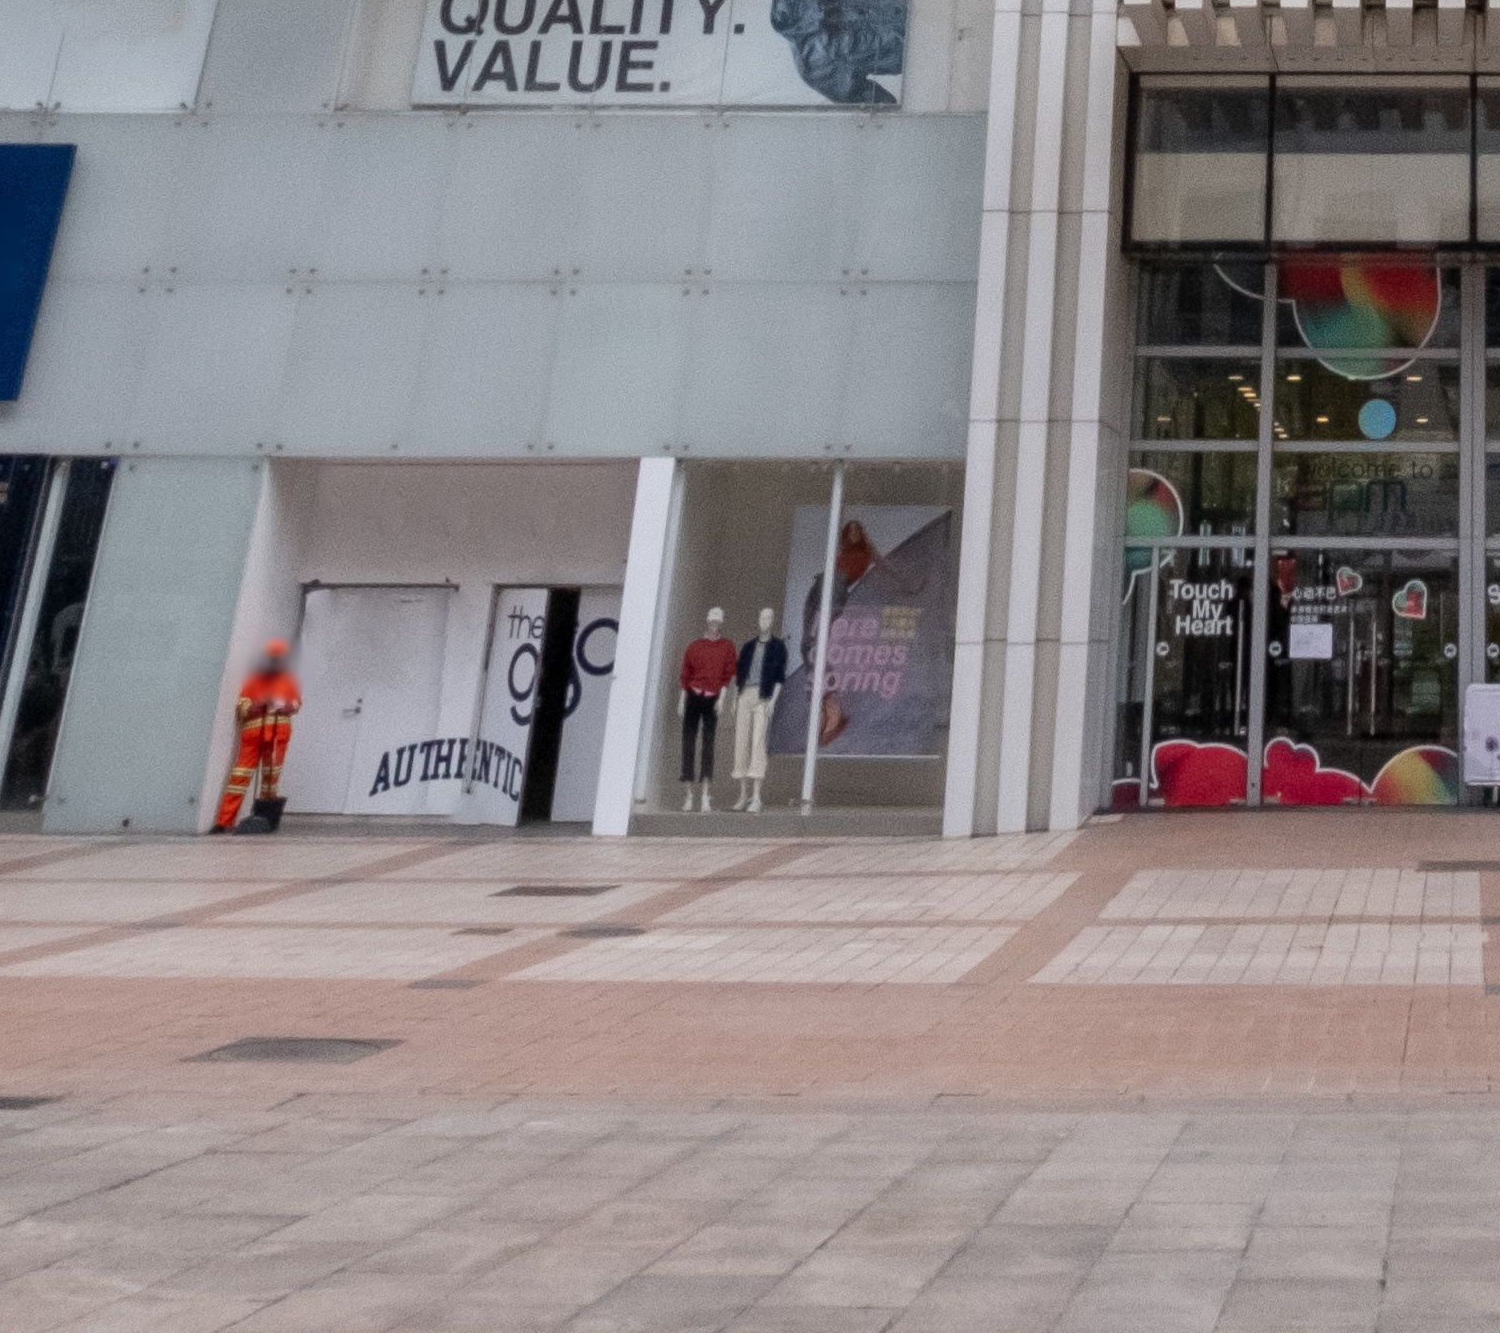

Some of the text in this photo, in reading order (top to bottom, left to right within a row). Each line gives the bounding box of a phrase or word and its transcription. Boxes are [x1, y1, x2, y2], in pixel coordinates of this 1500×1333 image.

[434, 39, 671, 93] VALUE.
[1169, 578, 1235, 600] Touch
[508, 605, 545, 639] the
[1192, 599, 1224, 621] My
[1174, 614, 1234, 635] Heart
[369, 737, 524, 802] AUTHENTIC
